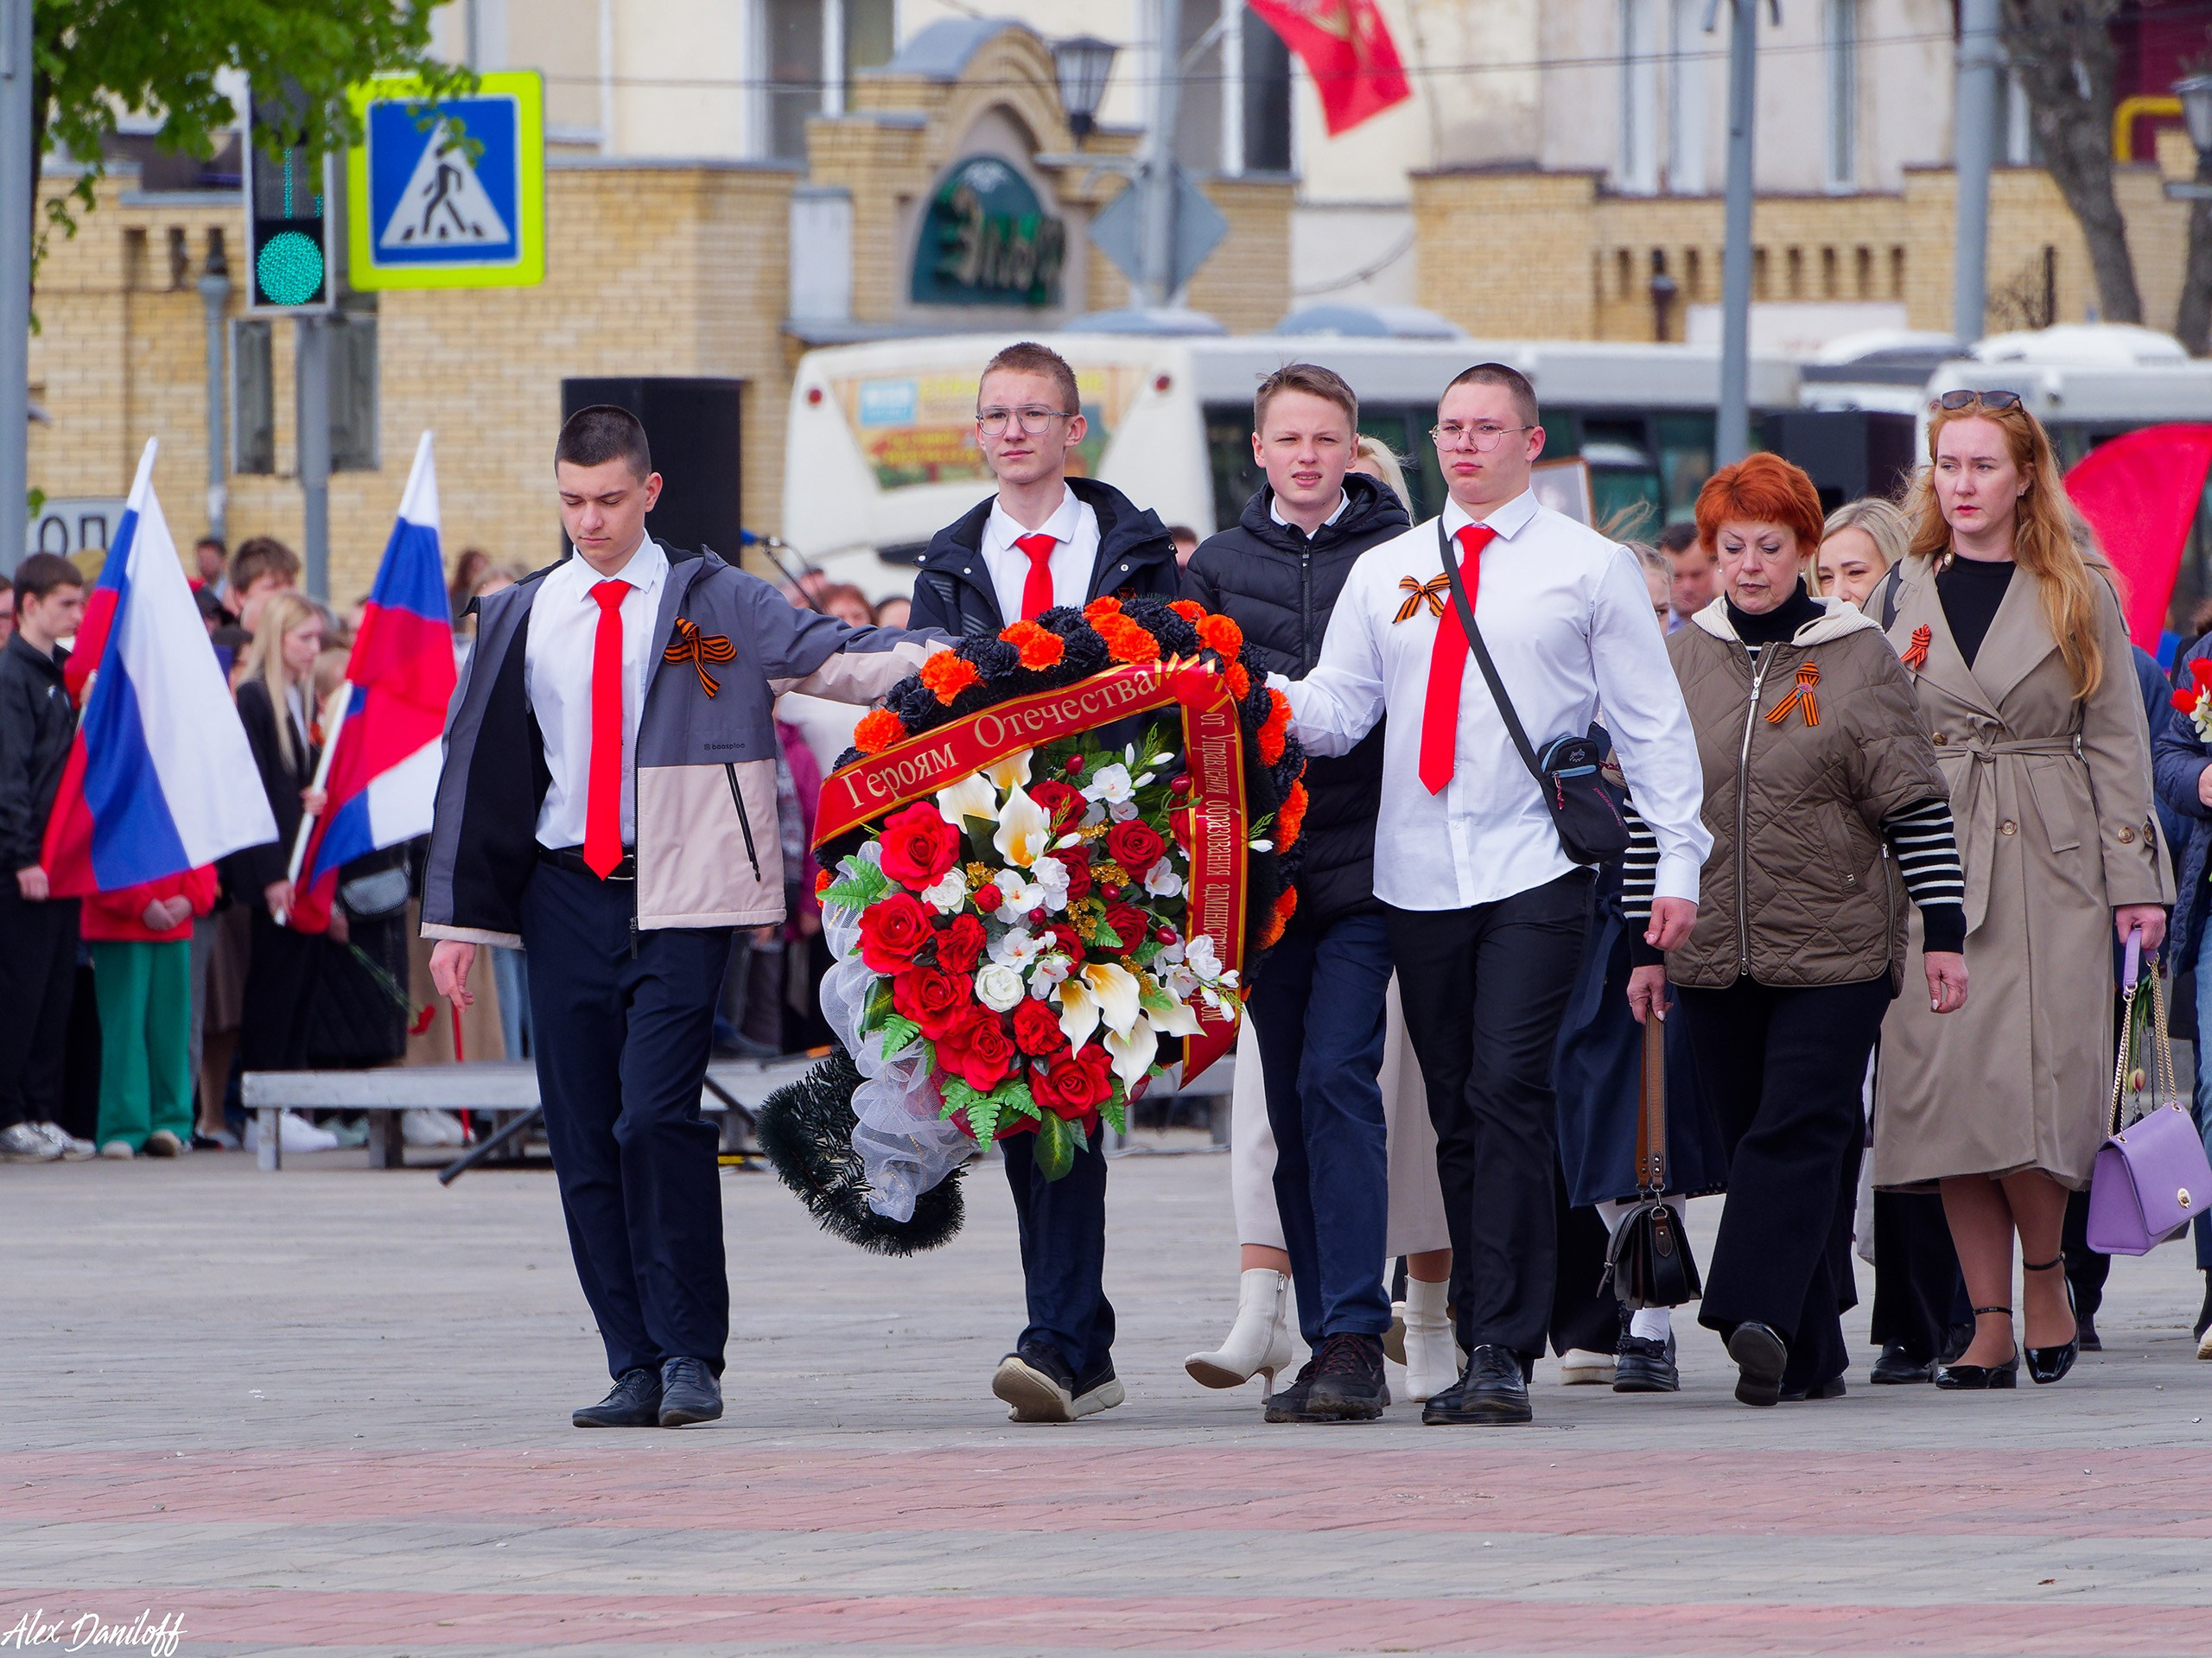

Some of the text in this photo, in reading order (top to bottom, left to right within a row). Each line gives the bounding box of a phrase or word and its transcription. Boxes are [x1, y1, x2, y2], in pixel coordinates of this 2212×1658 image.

[840, 670, 1158, 810] Героям Отечества
[1199, 713, 1226, 727] от
[1192, 733, 1236, 795] Управления
[1196, 800, 1242, 876] образования
